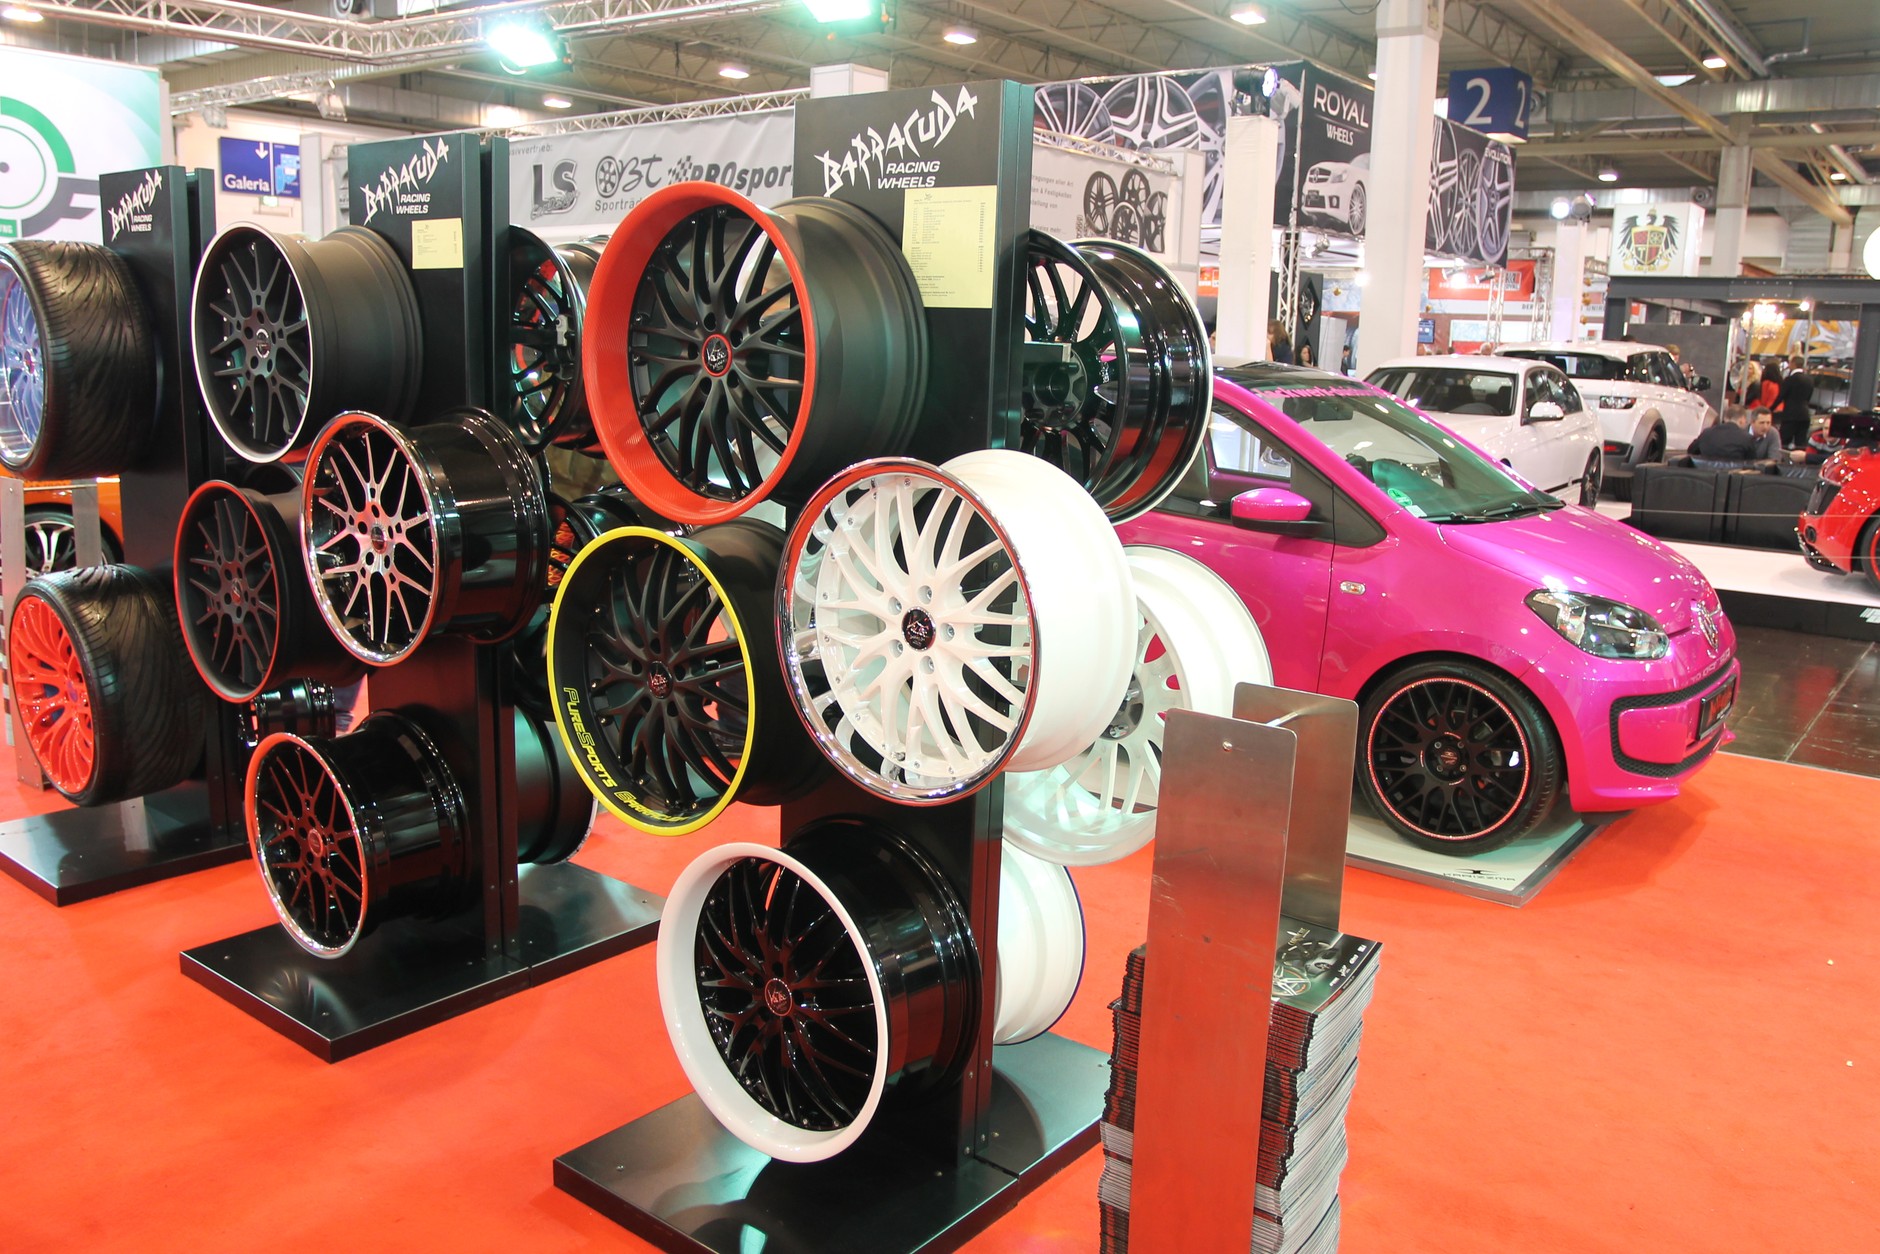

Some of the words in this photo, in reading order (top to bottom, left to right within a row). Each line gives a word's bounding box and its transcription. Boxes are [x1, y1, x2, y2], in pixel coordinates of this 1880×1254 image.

[1313, 83, 1369, 129] ROYAL
[1464, 77, 1492, 125] 2
[1515, 79, 1526, 129] 2
[814, 85, 978, 197] BARRACUDA
[1326, 123, 1354, 146] WHEELS
[689, 162, 793, 196] PROspor
[886, 160, 941, 175] RACING
[224, 174, 270, 192] Galeria
[360, 137, 449, 226] BARRACUDA
[877, 176, 936, 189] WHEELS
[107, 169, 162, 242] BARRACUDA
[396, 204, 429, 215] WHEELS
[400, 193, 430, 204] RACING
[131, 223, 152, 232] WHEELS
[133, 214, 152, 223] RACING
